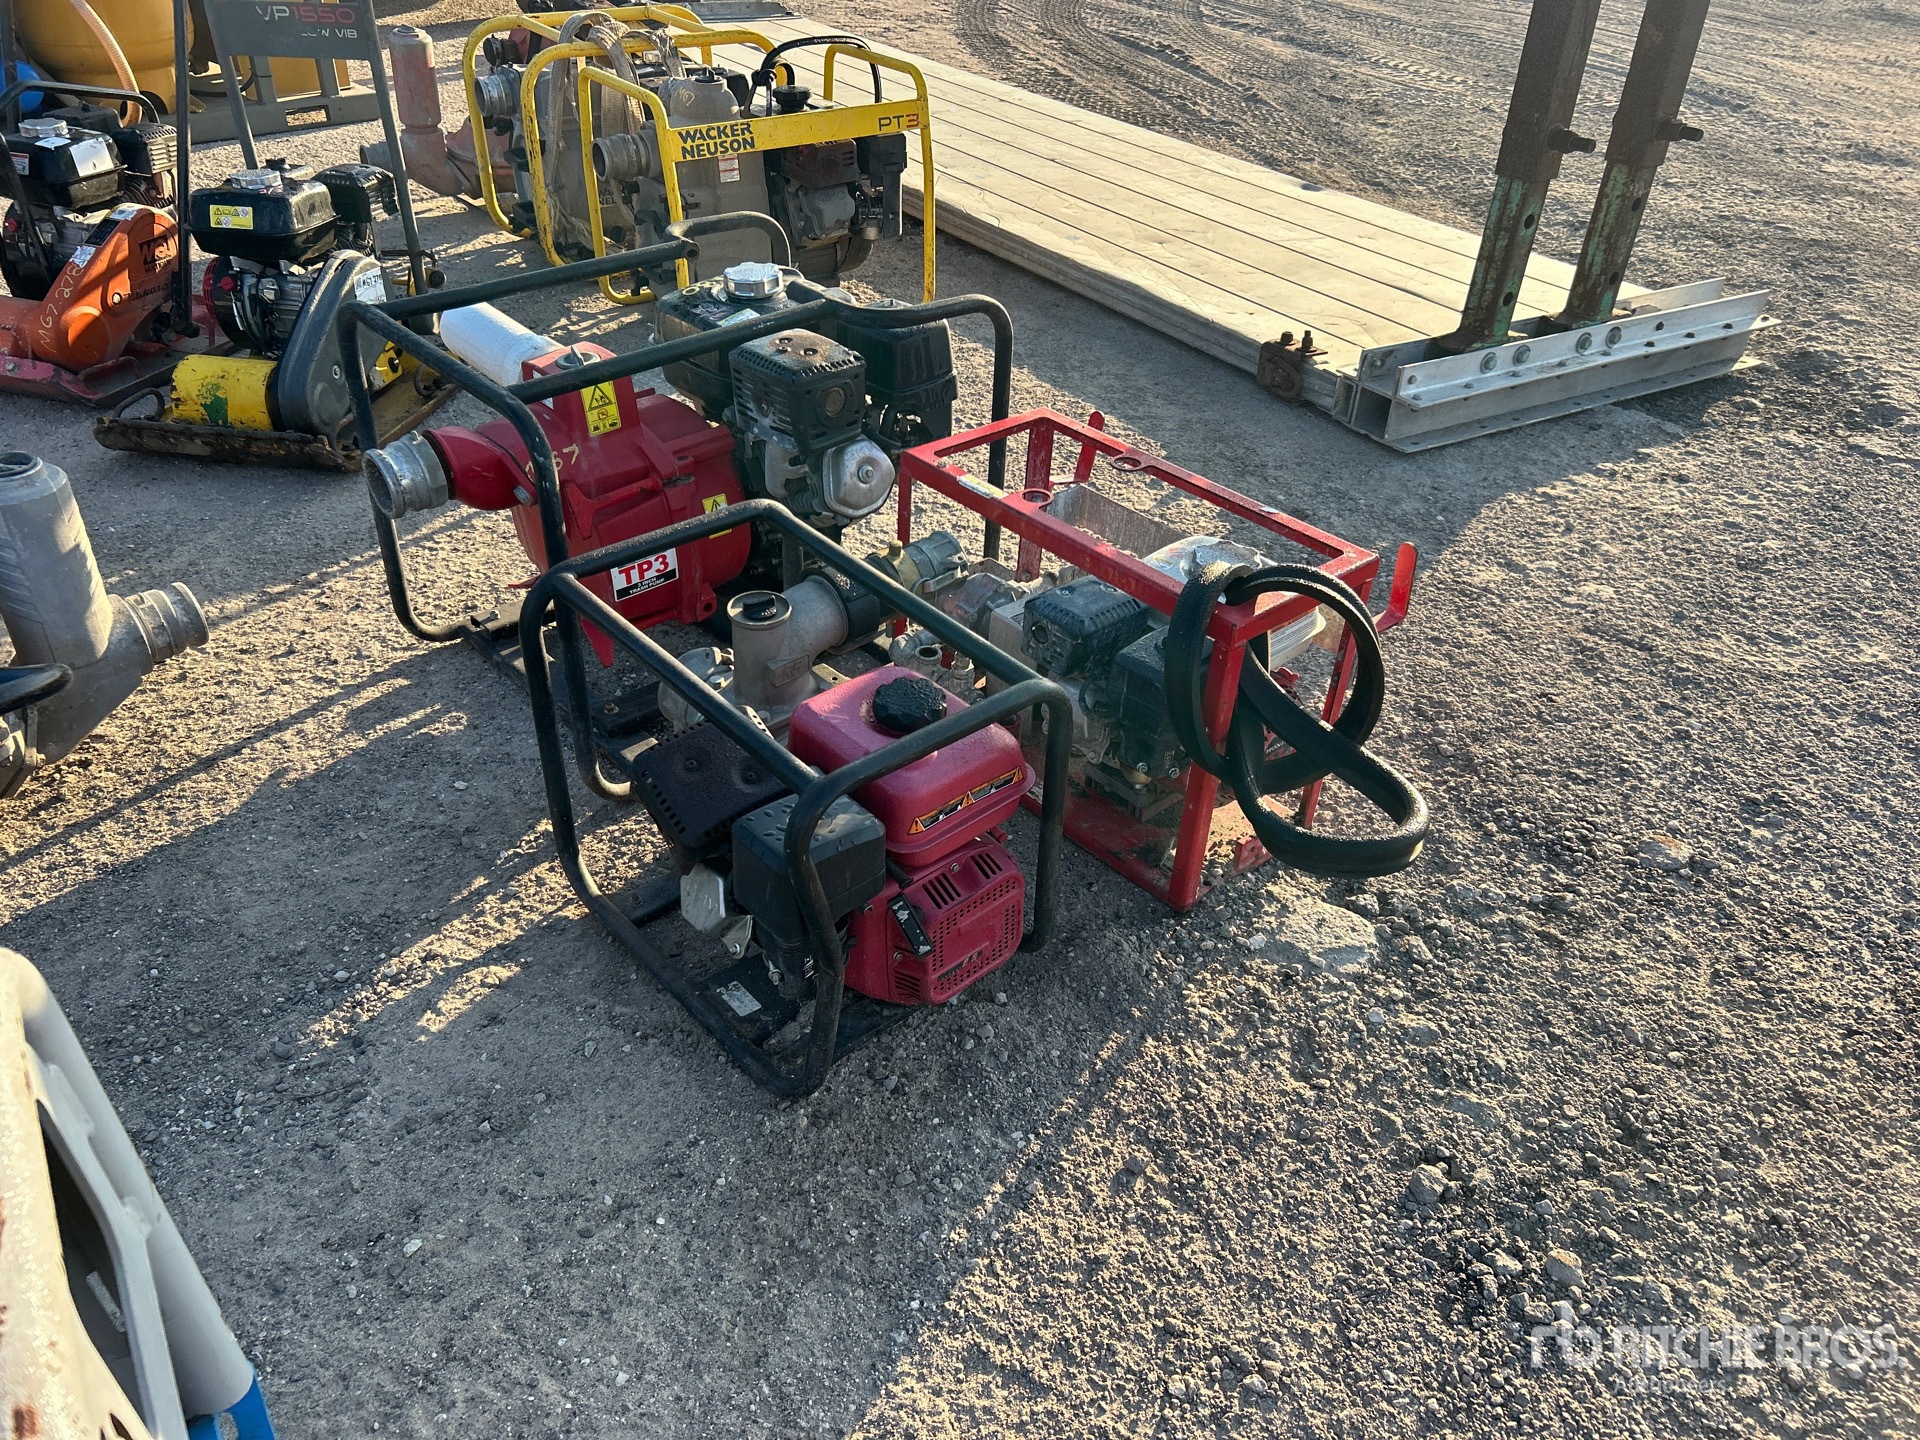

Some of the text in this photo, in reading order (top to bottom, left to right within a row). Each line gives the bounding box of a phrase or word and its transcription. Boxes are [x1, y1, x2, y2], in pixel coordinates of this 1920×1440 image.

[256, 5, 355, 24] VP1550
[335, 28, 358, 39] VIB
[878, 113, 920, 131] PT3
[677, 122, 754, 144] WACKER
[681, 136, 756, 159] NEUSON
[618, 553, 669, 585] TP3
[629, 578, 665, 594] TRASH PUMP
[642, 577, 657, 586] INCH
